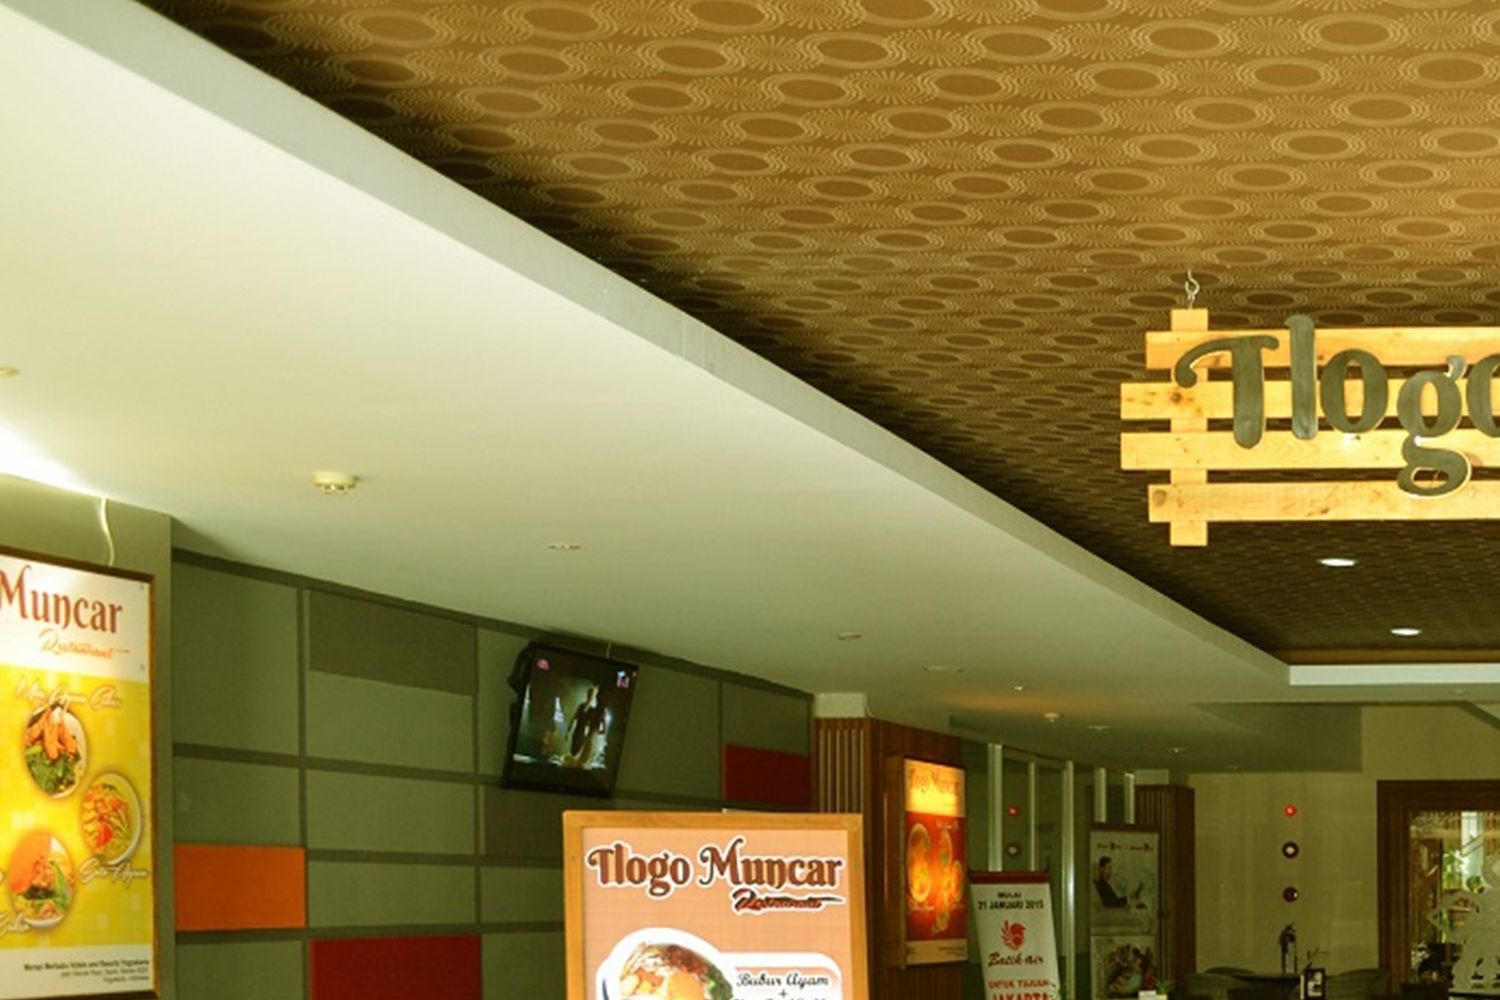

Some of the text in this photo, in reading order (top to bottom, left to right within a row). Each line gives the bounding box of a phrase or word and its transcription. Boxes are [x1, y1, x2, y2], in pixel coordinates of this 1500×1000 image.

[0, 565, 123, 634] Muncar
[588, 837, 843, 897] Tlogo Muncar
[779, 989, 788, 998] +
[786, 972, 829, 989] Ayam
